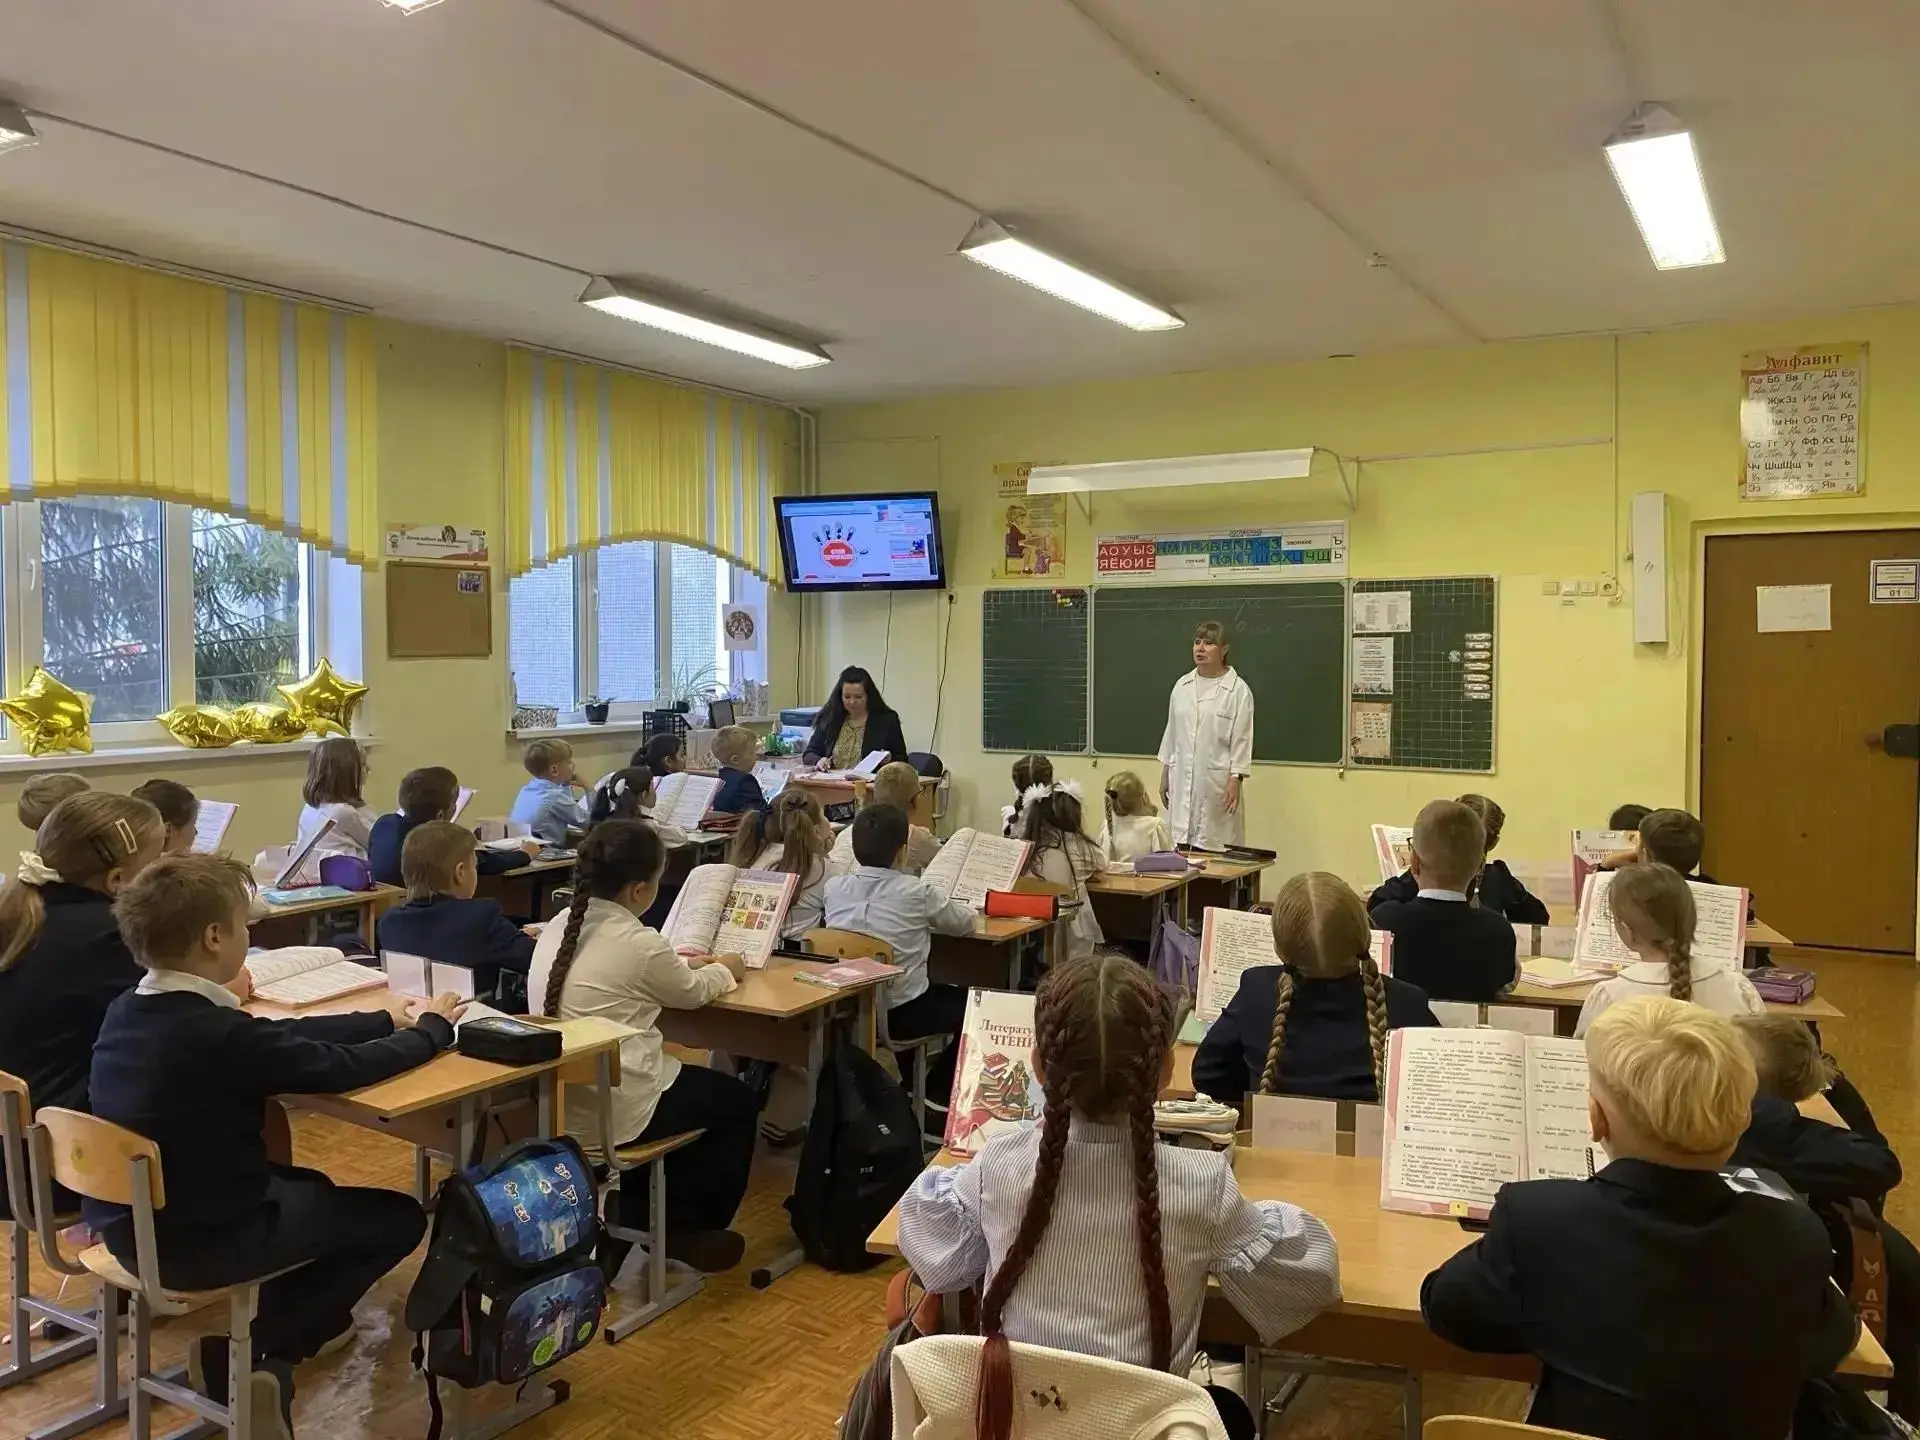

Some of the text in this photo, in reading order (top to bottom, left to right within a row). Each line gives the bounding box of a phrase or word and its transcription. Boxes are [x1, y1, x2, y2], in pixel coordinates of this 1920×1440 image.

[1766, 354, 1843, 369] Алфавит
[1767, 375, 1780, 383] Бб
[1785, 374, 1798, 382] Вв
[1823, 369, 1838, 378] Дд
[1803, 394, 1817, 402] Ии
[1785, 417, 1798, 425] Нн
[1803, 416, 1817, 424] Оо
[1840, 413, 1854, 422] Рр
[1802, 437, 1818, 445] Фф
[1822, 436, 1834, 444] Хх
[979, 1018, 1035, 1037] Литерату
